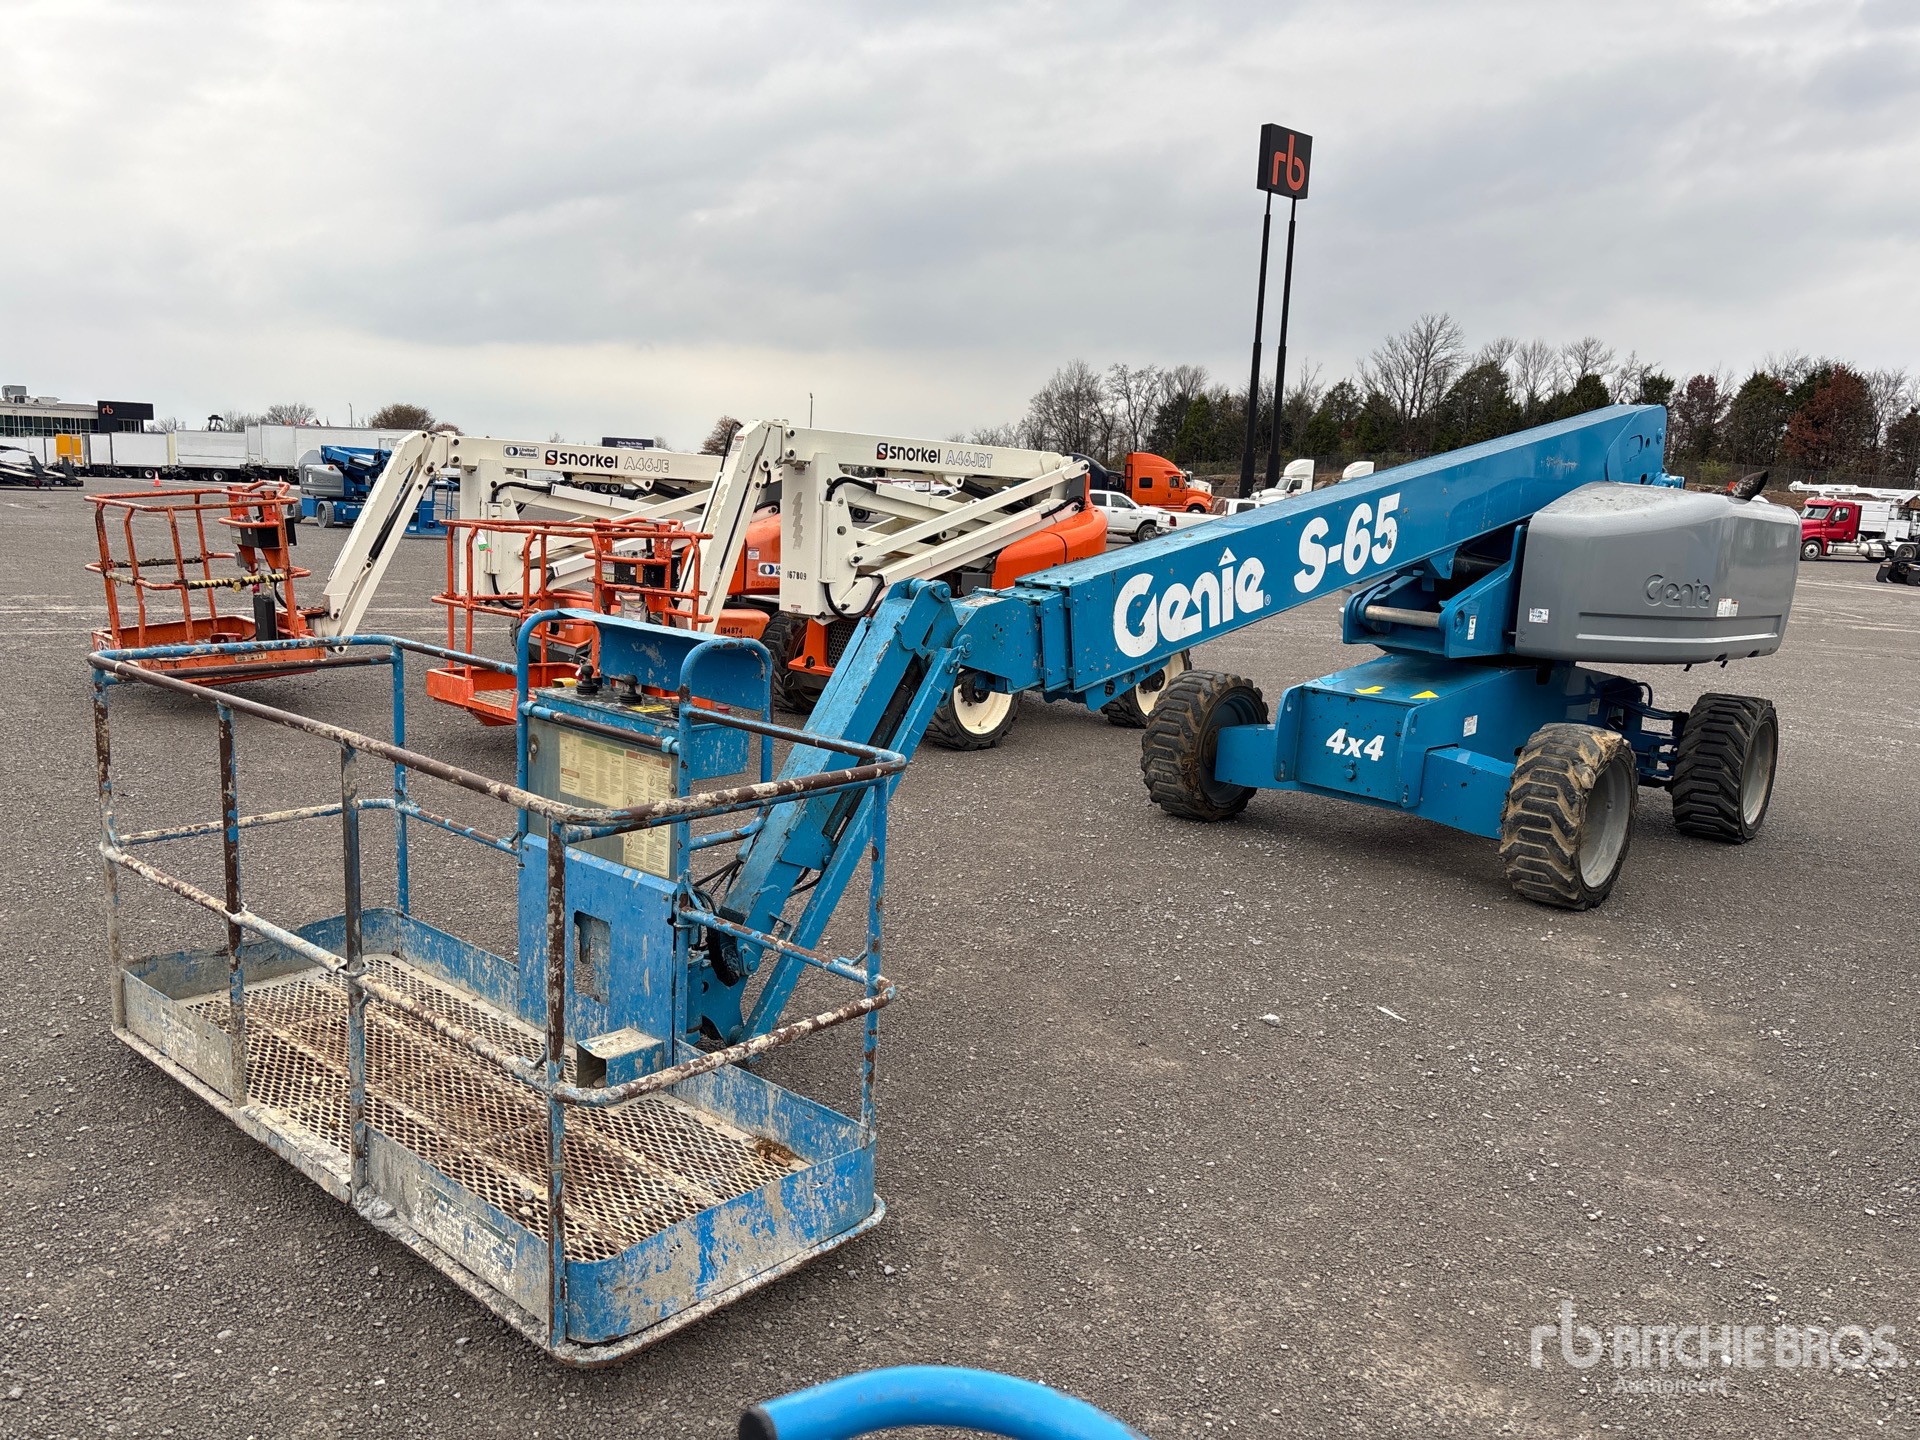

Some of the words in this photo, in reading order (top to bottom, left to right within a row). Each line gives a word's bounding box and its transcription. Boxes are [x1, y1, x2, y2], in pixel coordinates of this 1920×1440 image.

[1272, 134, 1305, 191] rb
[102, 405, 113, 414] rb
[560, 452, 618, 469] snorkel
[624, 457, 670, 473] A46JE
[889, 446, 941, 464] snorkel
[945, 450, 994, 468] A46JRT
[1113, 547, 1265, 658] Genie
[1293, 492, 1401, 594] S-65
[1642, 574, 1711, 609] Genie
[1325, 728, 1385, 762] 4x4
